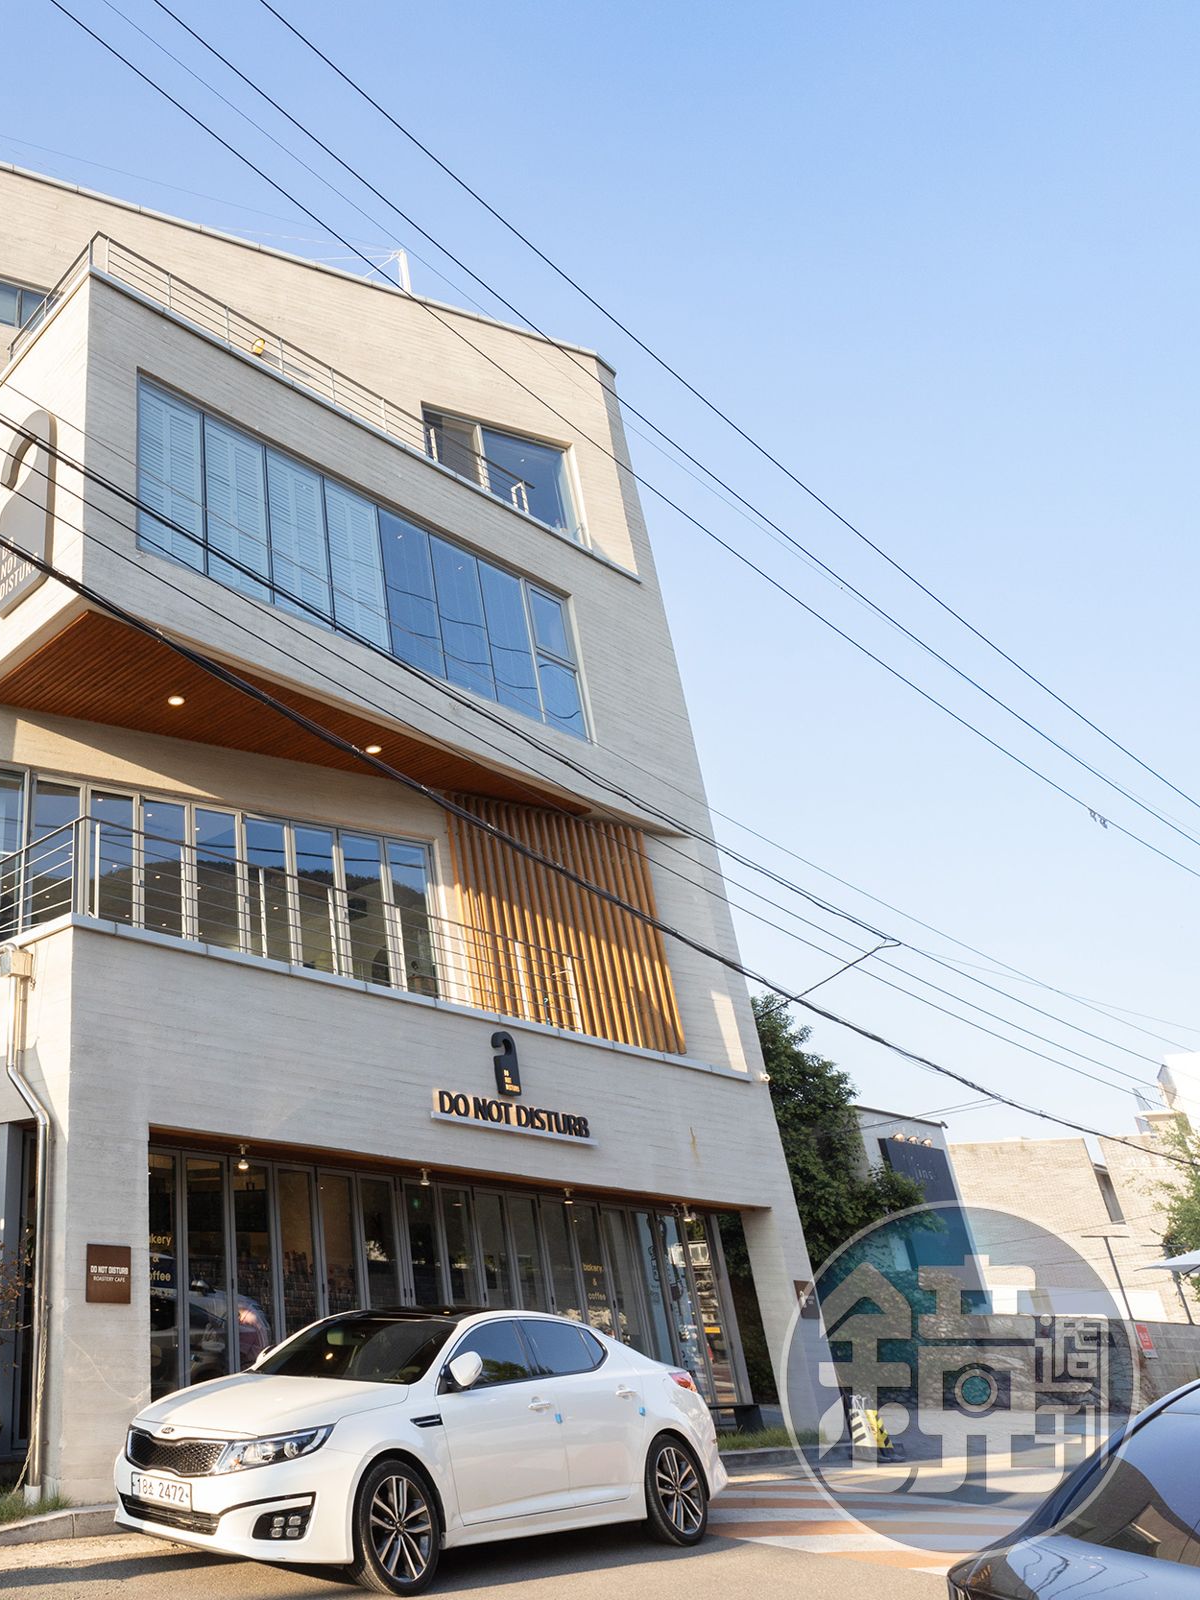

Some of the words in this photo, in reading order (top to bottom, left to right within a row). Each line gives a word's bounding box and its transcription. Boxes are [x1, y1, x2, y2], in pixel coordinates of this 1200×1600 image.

[439, 1090, 470, 1116] DO
[473, 1096, 513, 1125] NOT
[516, 1105, 590, 1138] DISTURB
[90, 1265, 98, 1273] DO
[98, 1266, 108, 1274] NOT
[108, 1266, 129, 1275] DISTURB
[158, 1482, 185, 1502] 2472
